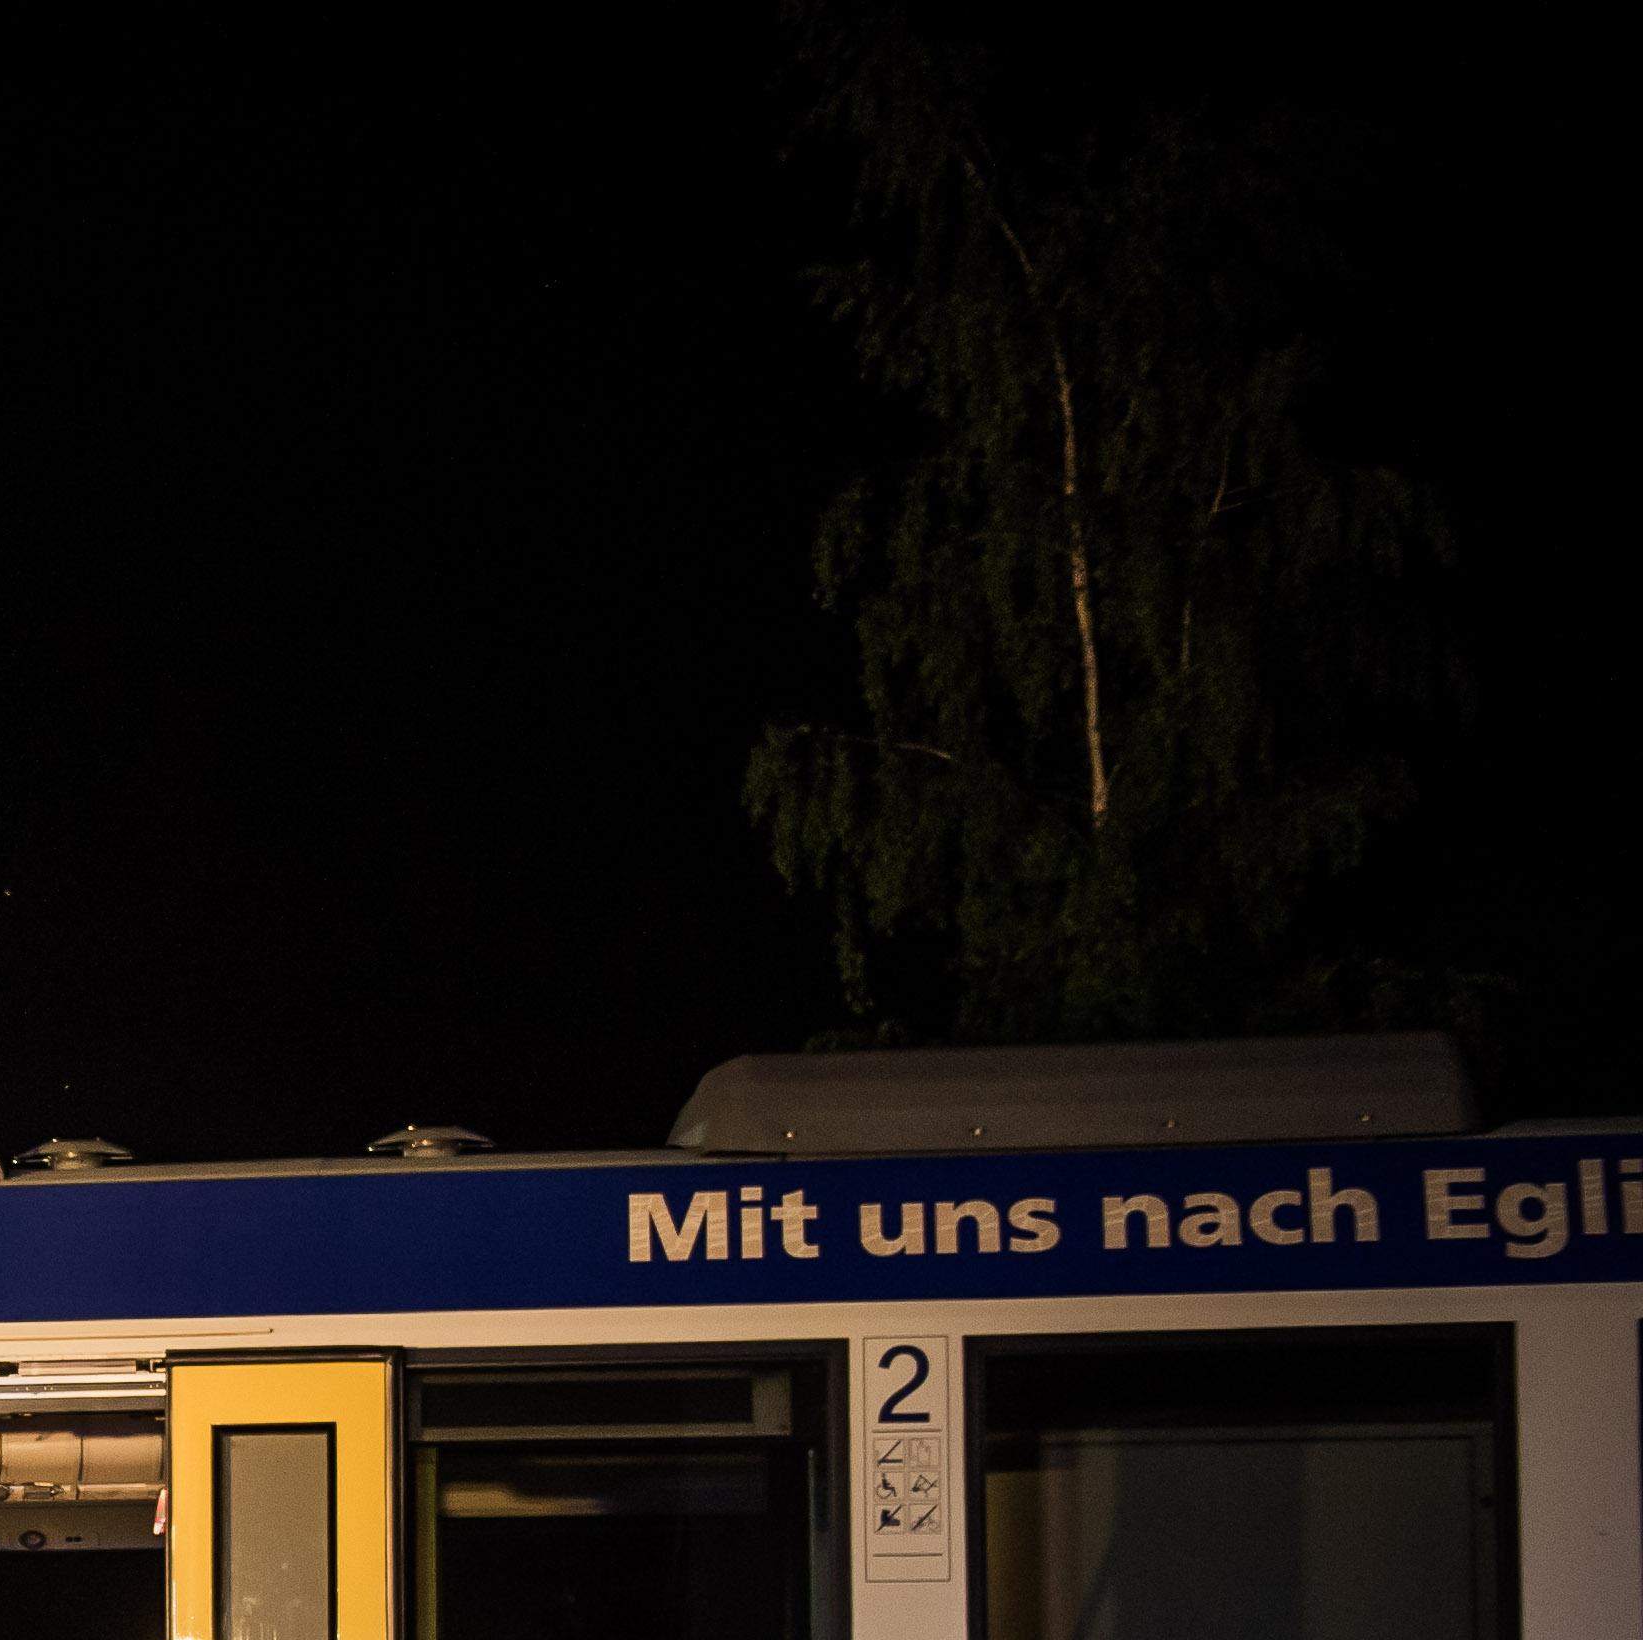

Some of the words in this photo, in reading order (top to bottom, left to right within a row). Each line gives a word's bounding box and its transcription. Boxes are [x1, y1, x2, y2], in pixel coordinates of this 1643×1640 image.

[628, 1186, 820, 1263] Mit
[858, 1197, 1062, 1257] uns
[1101, 1166, 1382, 1250] nach
[878, 1345, 931, 1424] 2
